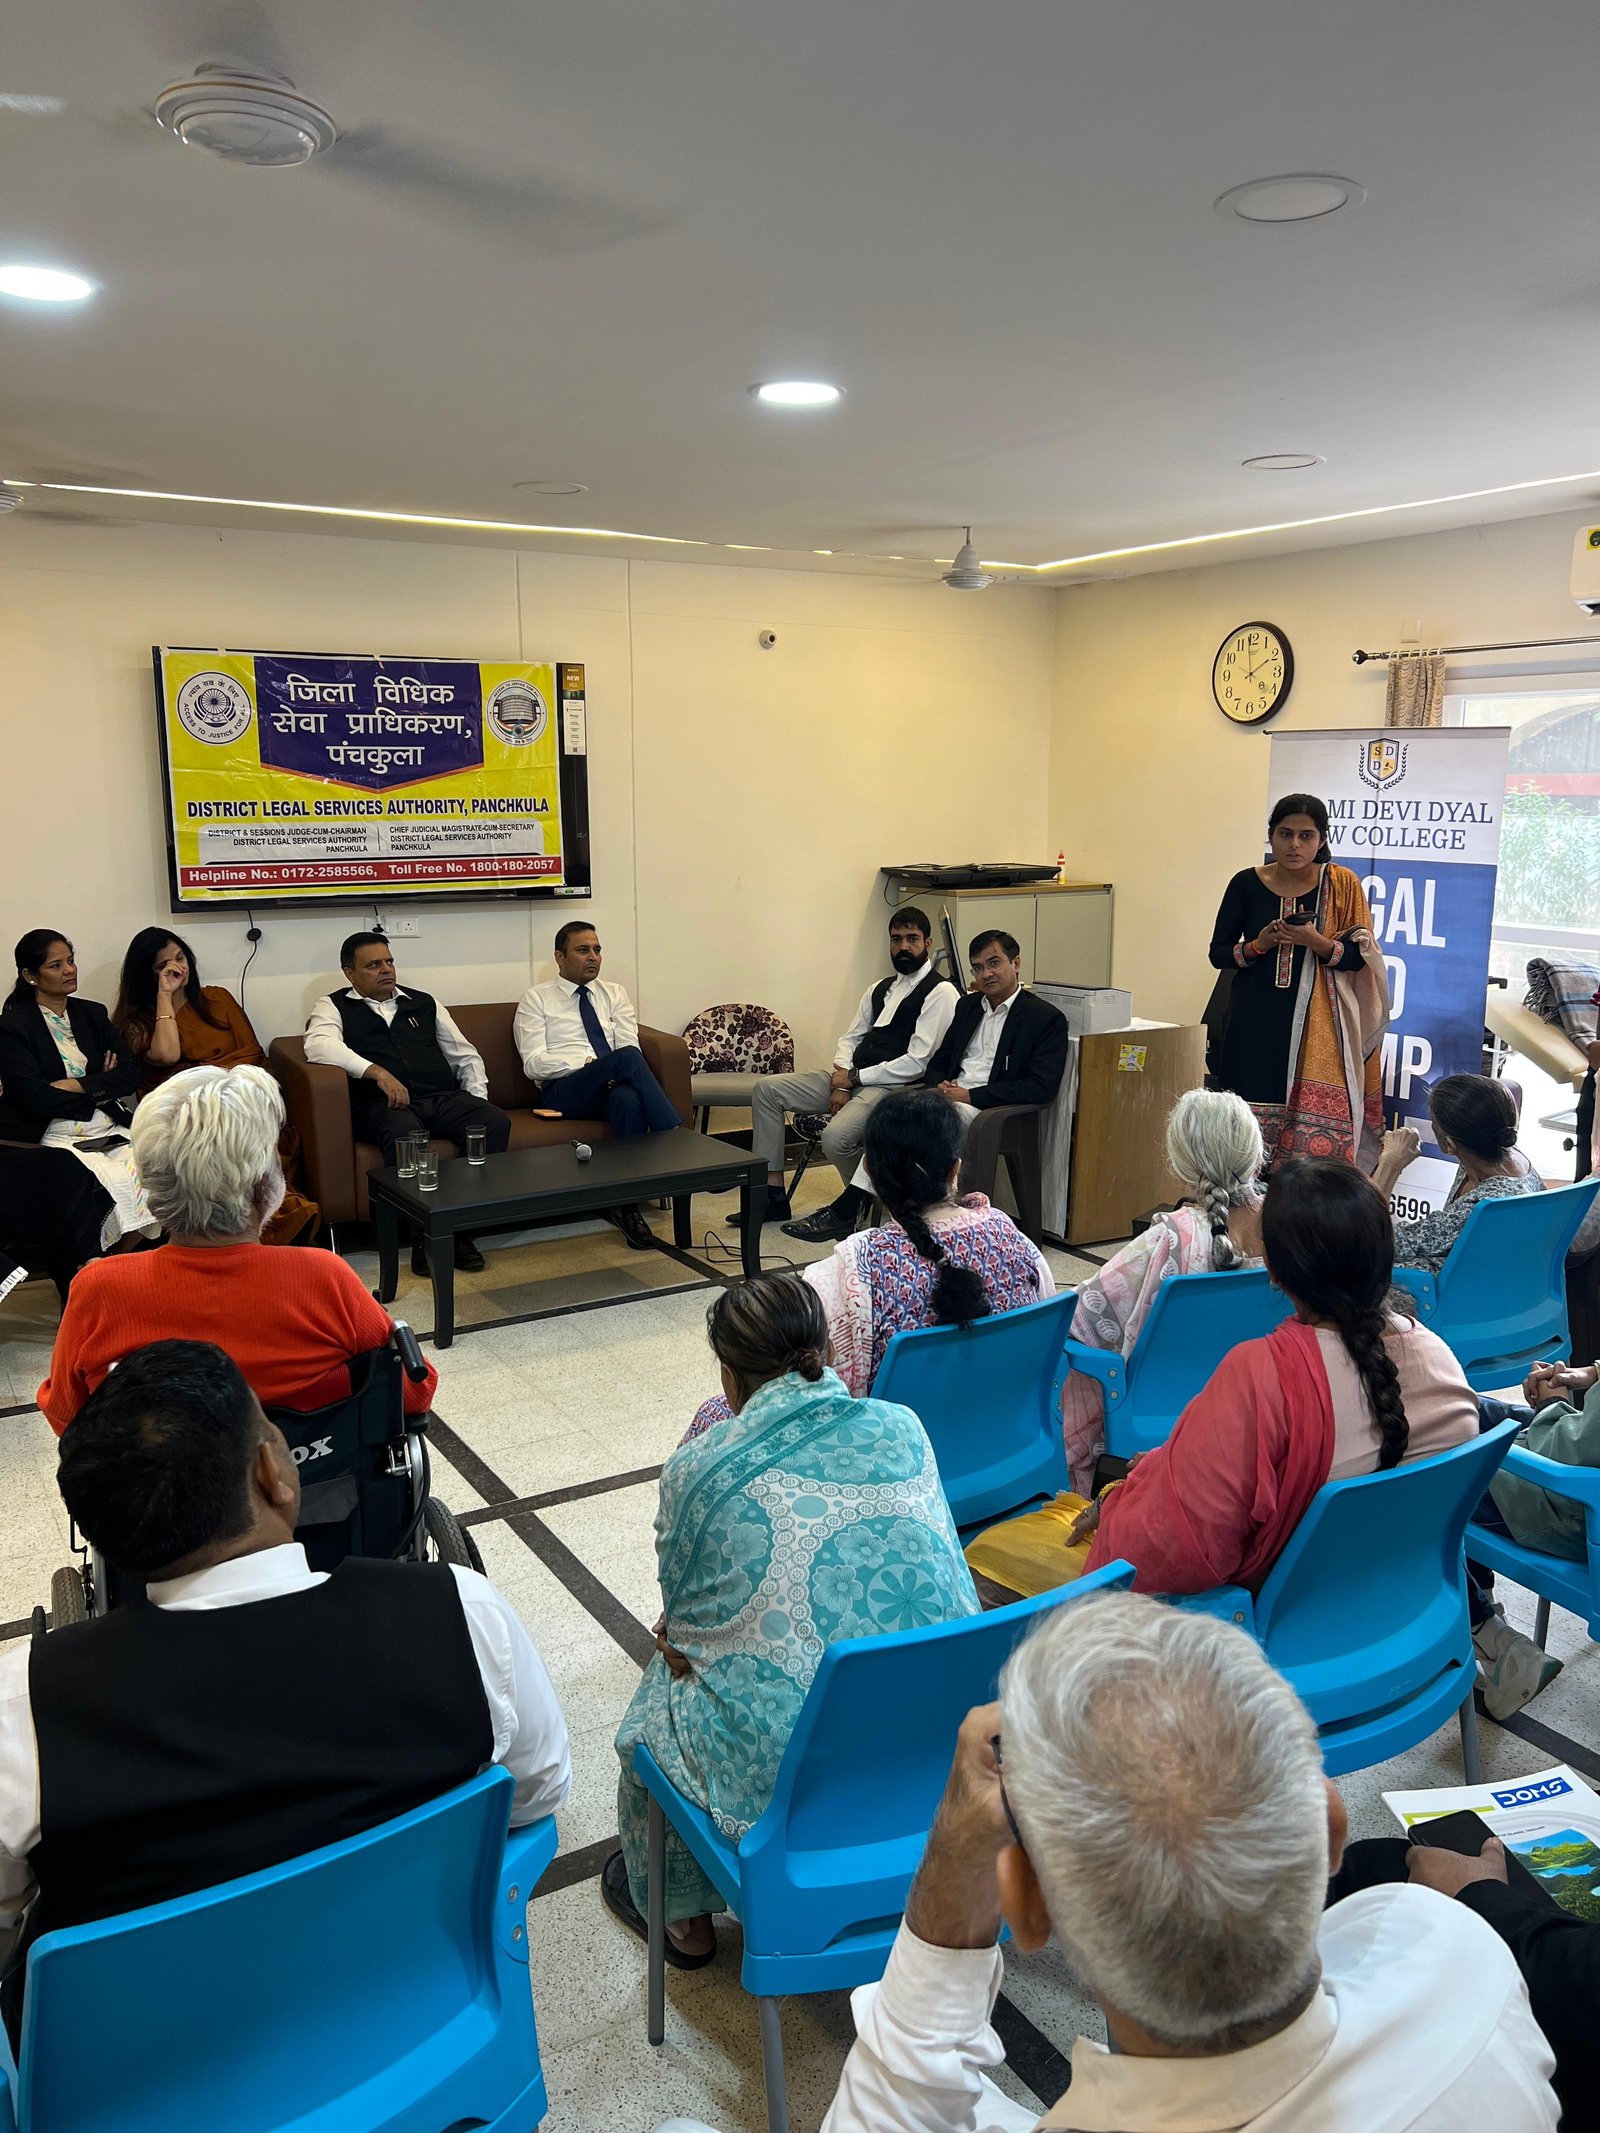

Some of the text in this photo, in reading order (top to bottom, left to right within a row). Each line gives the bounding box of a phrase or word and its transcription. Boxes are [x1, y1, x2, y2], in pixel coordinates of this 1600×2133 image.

[1237, 638, 1244, 651] 11
[1248, 632, 1259, 645] 12
[1227, 652, 1236, 665] 10
[1272, 648, 1279, 661] 2
[1223, 669, 1231, 682] 9
[1273, 666, 1282, 678] 3
[286, 673, 454, 704] जिला विधिक
[1225, 686, 1232, 698] 8
[1269, 683, 1277, 695] 4
[1234, 698, 1241, 710] 7
[1246, 702, 1254, 714] 6
[1259, 697, 1267, 709] 5
[184, 703, 196, 727] ACCESS
[208, 730, 234, 738] JUSTICE
[234, 718, 244, 730] FOR
[270, 704, 472, 738] सेवा प्राधिकरण,
[326, 740, 425, 774] पंचकुला
[188, 798, 549, 817] DISTRICT LEGAL SERVICES AUTHORITY, PANCHKULA
[1328, 800, 1493, 824] MI DEVI DYAL
[287, 828, 367, 836] JUDGE-CUM-CHAIRMAN
[442, 824, 534, 832] MAGISTRATE-CUM-SECRETARY
[234, 838, 266, 846] DISTRICT
[292, 837, 327, 845] SERVICES
[328, 836, 367, 844] AUTHORITY
[1352, 826, 1466, 850] COLLEGE
[326, 845, 368, 853] PANCHKULA
[389, 860, 554, 874] Toll Free No. 1800-180-2057
[189, 866, 377, 882] Helpline No.: 0172-2585566,
[1360, 875, 1446, 948] GAL
[1388, 1193, 1430, 1220] 6599
[289, 1436, 333, 1466] OX
[1497, 1780, 1562, 1805] DOMS
